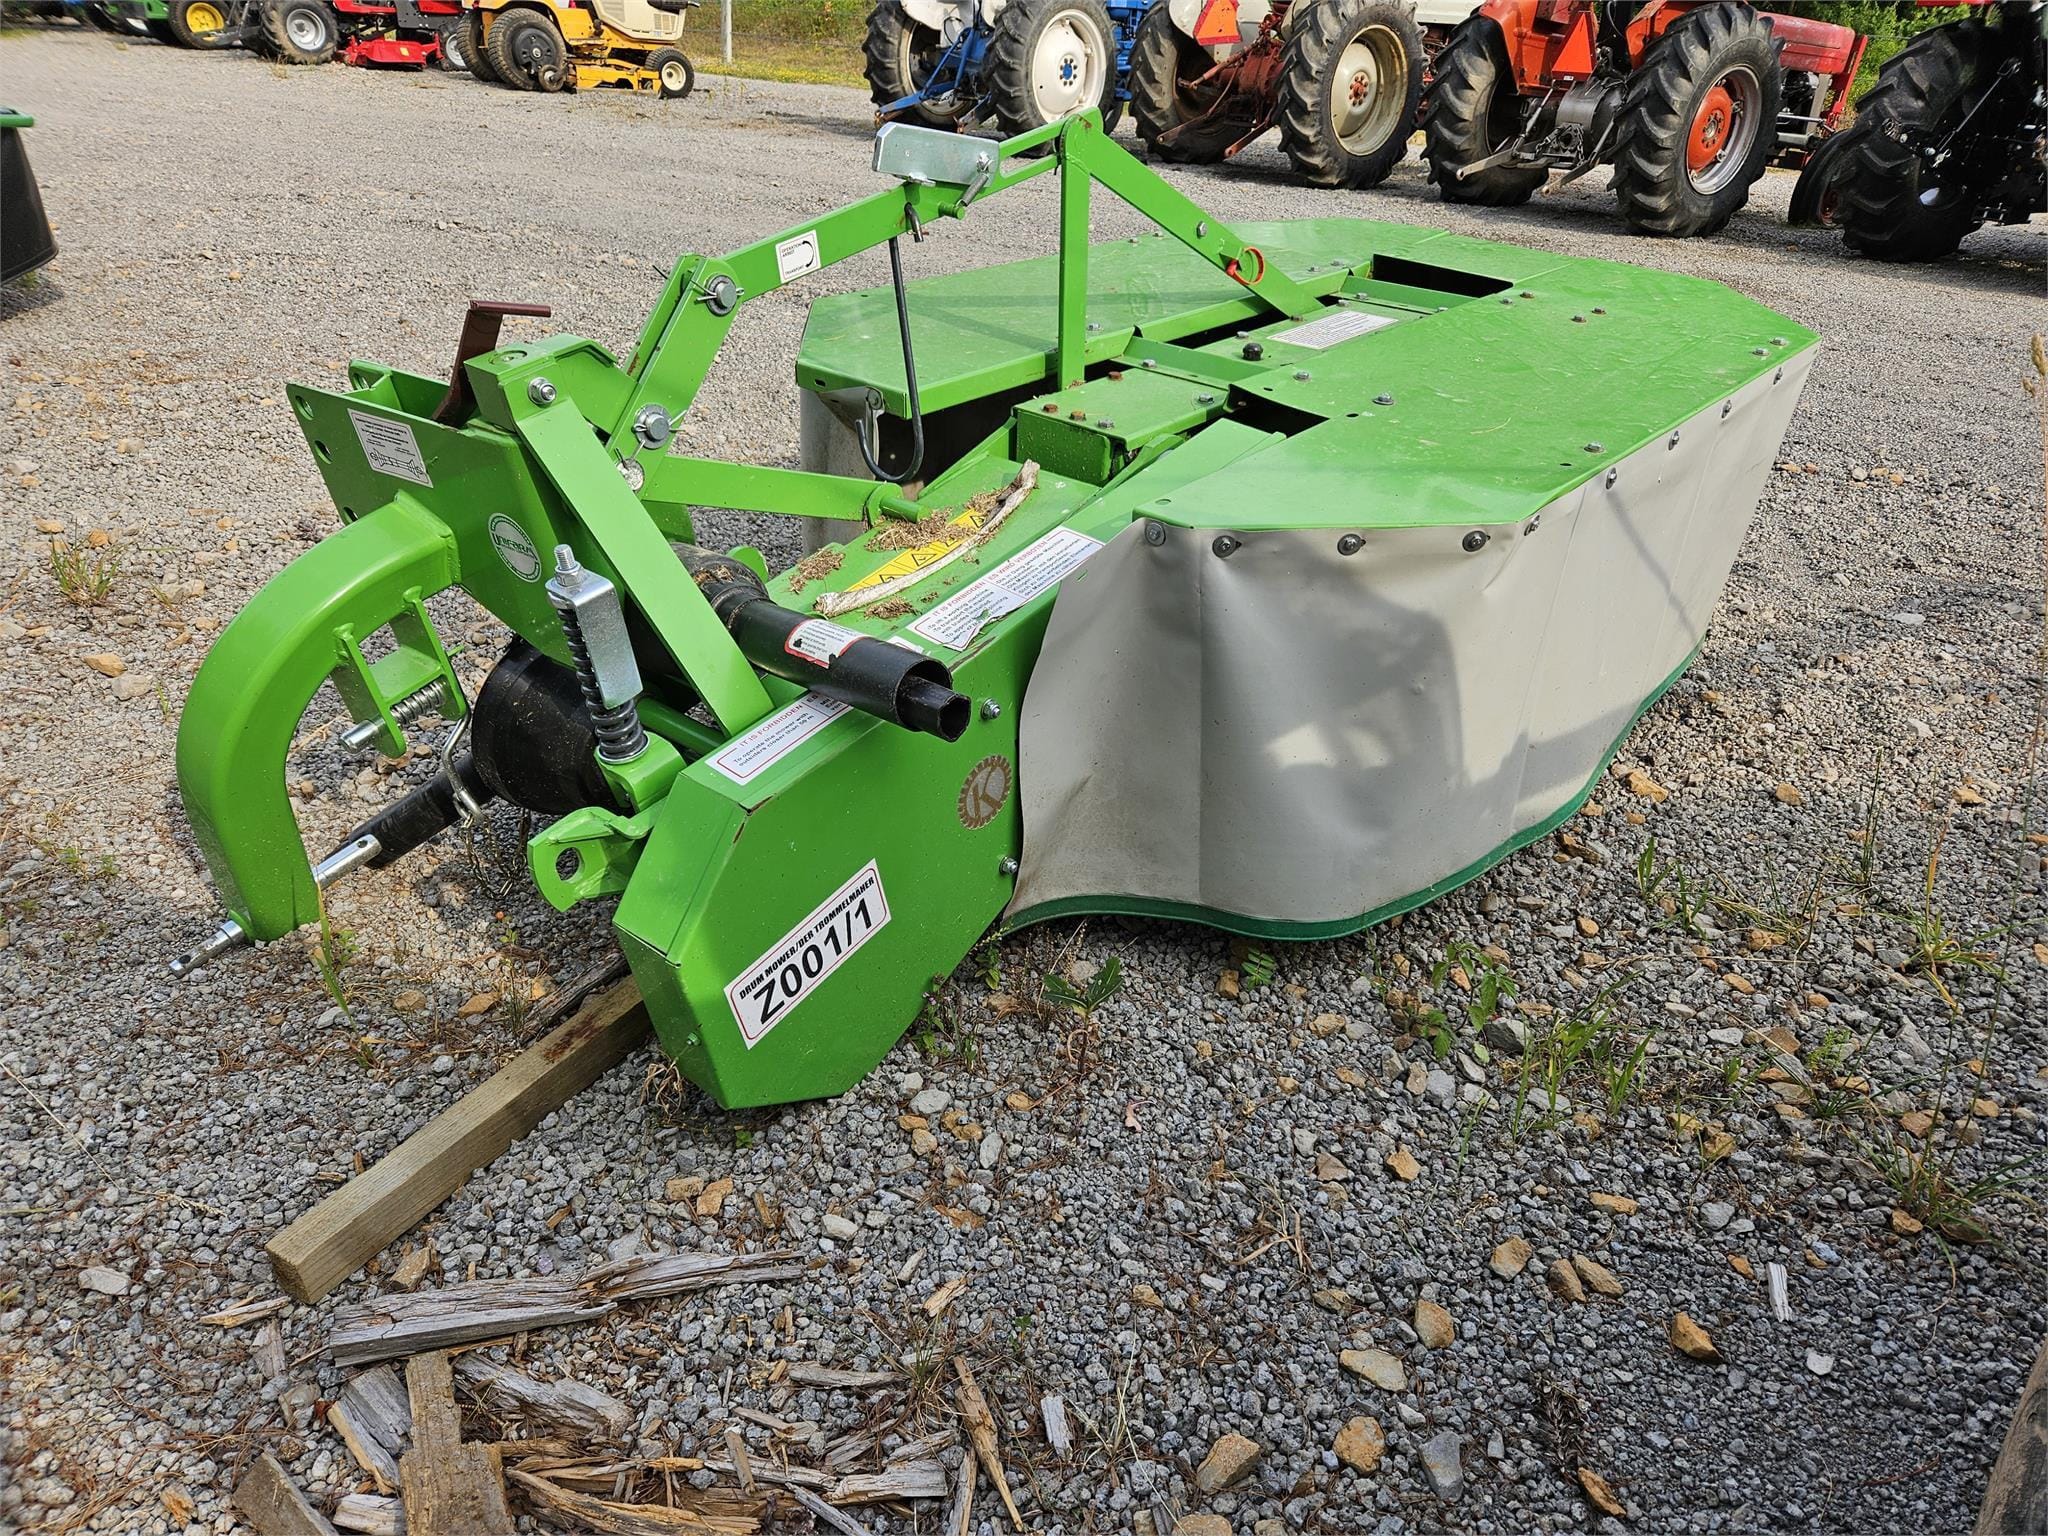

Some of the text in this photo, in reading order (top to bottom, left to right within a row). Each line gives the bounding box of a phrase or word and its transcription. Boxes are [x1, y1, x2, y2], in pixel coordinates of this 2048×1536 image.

[1014, 541, 1048, 562] VERBOTEN
[946, 581, 986, 606] FORBIDDEN
[940, 611, 964, 626] transport
[947, 602, 968, 616] working
[756, 704, 803, 734] FORBIDDEN
[738, 747, 767, 766] outsiders
[766, 734, 786, 747] closer
[742, 742, 765, 757] operate
[775, 721, 795, 734] mower
[739, 877, 874, 1000] DRUM MOWER/DER TROMMELMÄHER
[753, 898, 872, 1024] Z001/1
